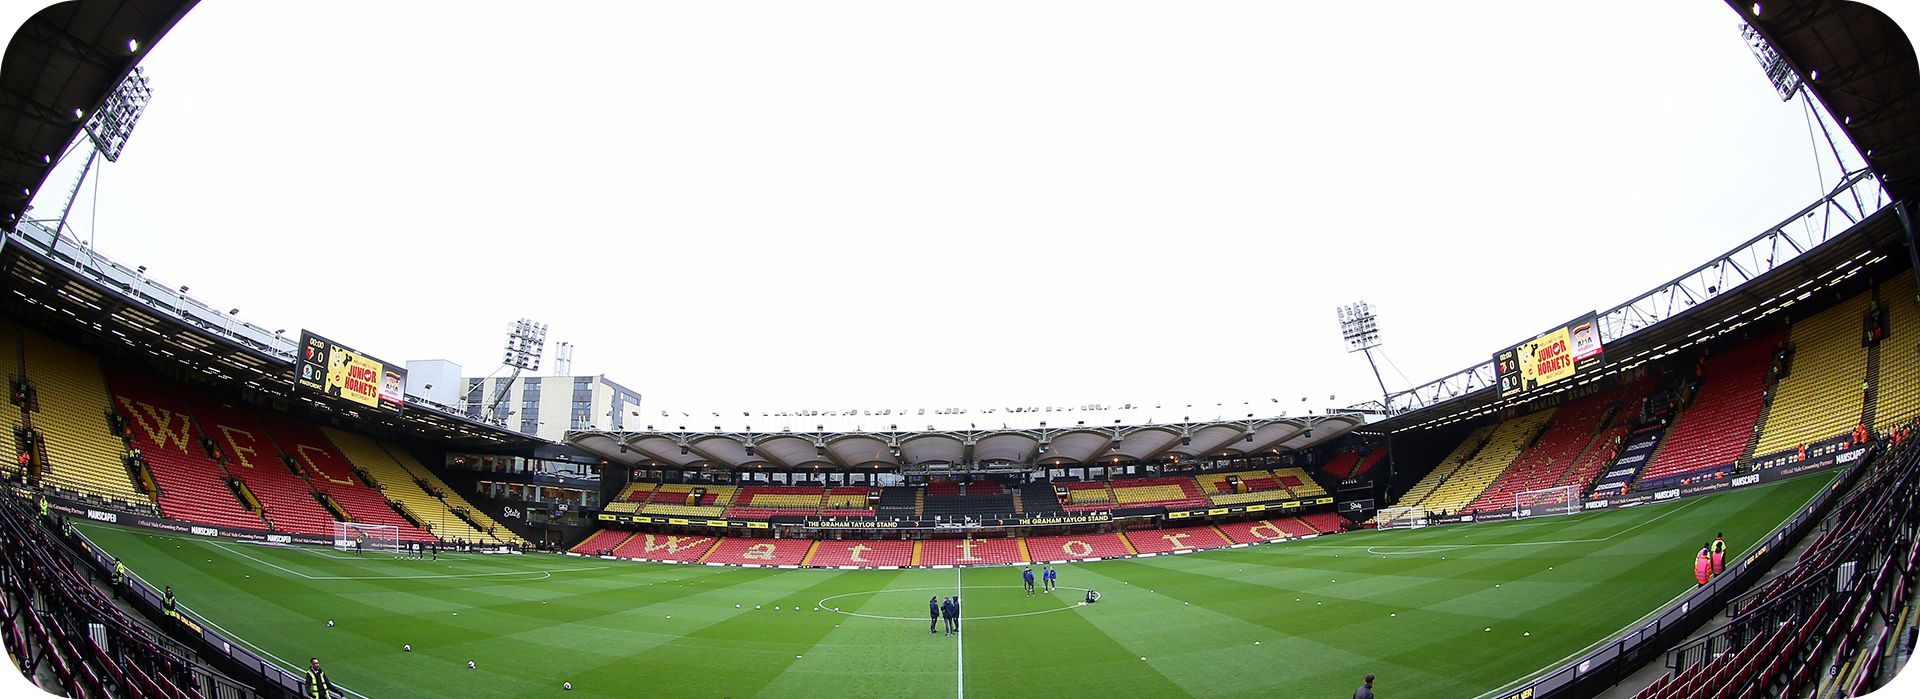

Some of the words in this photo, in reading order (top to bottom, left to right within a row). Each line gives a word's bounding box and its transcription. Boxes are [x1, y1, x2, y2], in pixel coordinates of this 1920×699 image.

[309, 337, 325, 349] 00:00
[1537, 339, 1567, 363] JUNIOR
[317, 352, 324, 363] 0
[1509, 360, 1515, 370] 0
[1536, 353, 1571, 377] HORNETS
[315, 369, 321, 381] 0
[347, 364, 377, 384] JUNIOR
[1511, 375, 1518, 386] 0
[344, 376, 377, 398] HORNETS
[1529, 395, 1561, 412] FAMILY
[1567, 383, 1600, 401] STAND
[1731, 473, 1760, 487] MANSCAPED
[1654, 488, 1680, 500] MANSCAPED
[87, 509, 117, 523] MANSCAPED
[1032, 517, 1062, 525] GRAHAM
[191, 525, 218, 537] MANSCAPED
[267, 534, 291, 544] MANSCAPED
[24, 659, 31, 669] C
